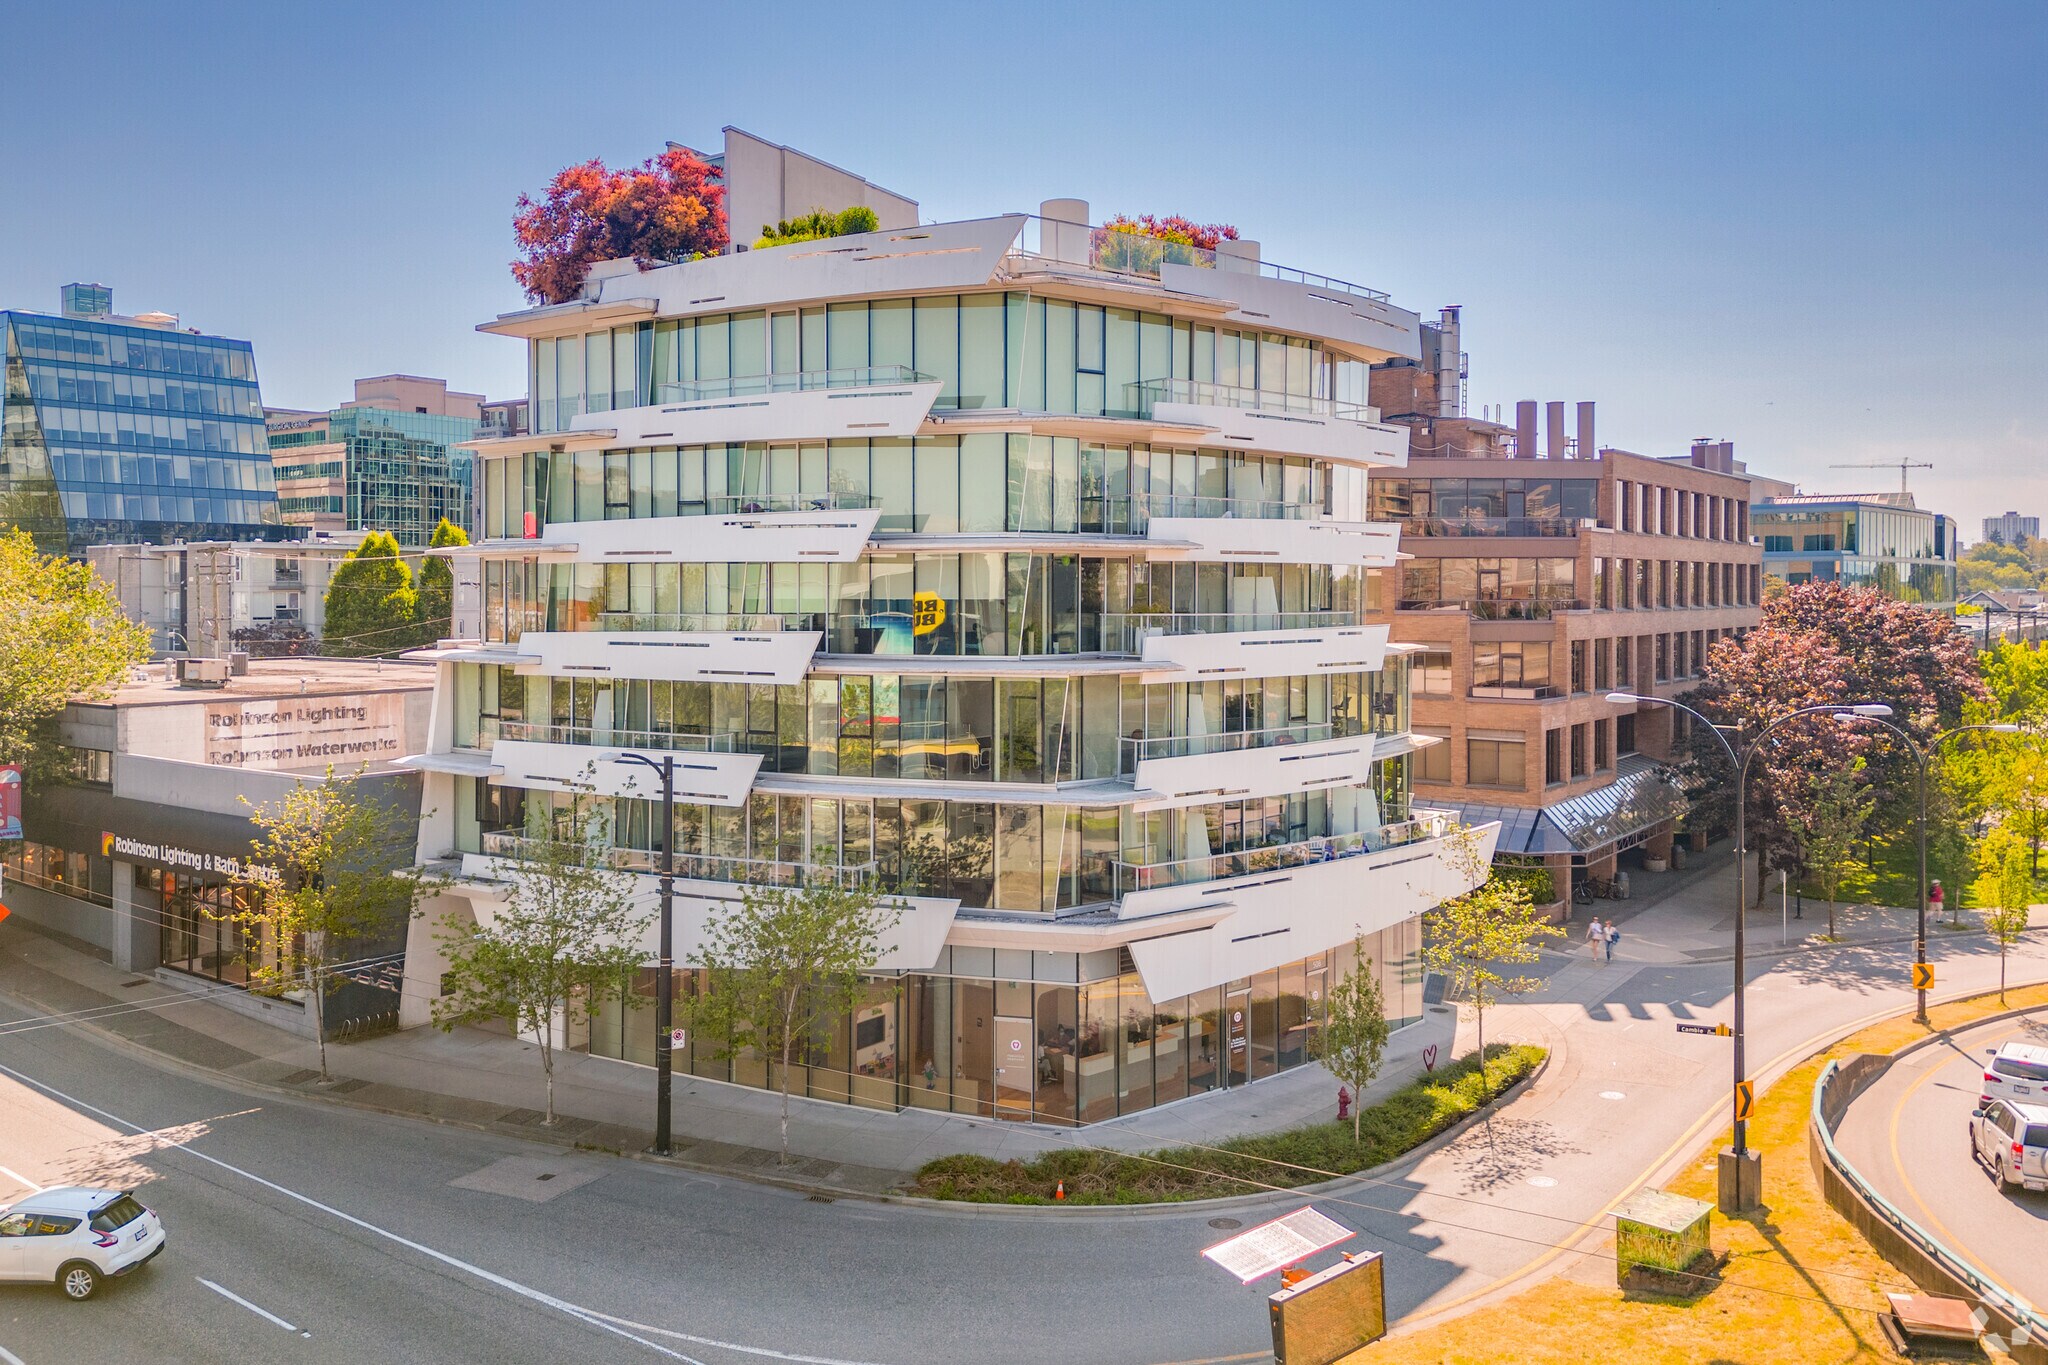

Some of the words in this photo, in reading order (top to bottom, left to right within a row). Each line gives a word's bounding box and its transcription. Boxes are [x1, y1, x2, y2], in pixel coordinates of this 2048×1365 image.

[296, 705, 368, 724] Lighting
[296, 738, 397, 758] Waterworks
[115, 836, 159, 860] Robinson
[160, 845, 202, 871] Lighting
[204, 854, 212, 871] &
[1681, 1026, 1704, 1034] Cambie
